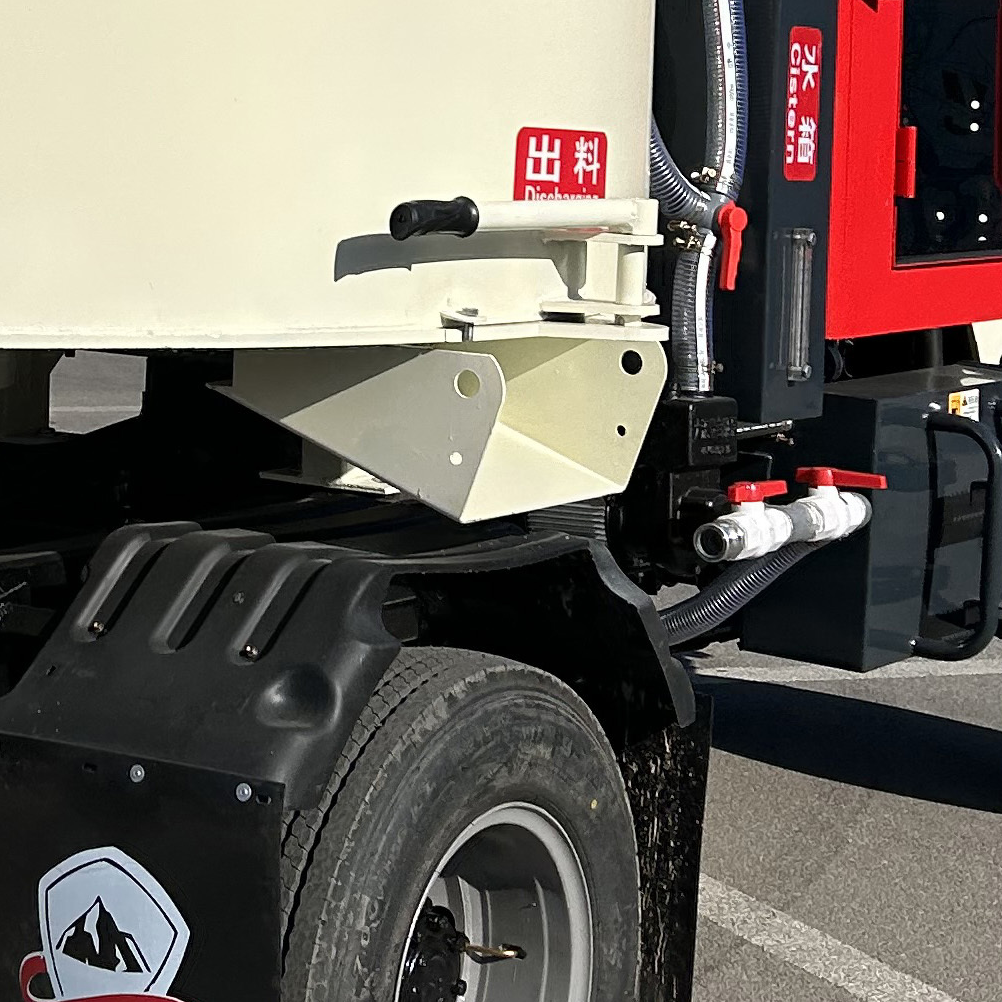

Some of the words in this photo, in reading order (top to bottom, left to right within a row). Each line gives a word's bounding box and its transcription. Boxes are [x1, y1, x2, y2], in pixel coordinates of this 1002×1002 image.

[525, 134, 601, 185] 出料
[786, 42, 802, 165] Cistern
[797, 43, 819, 164] 水箱
